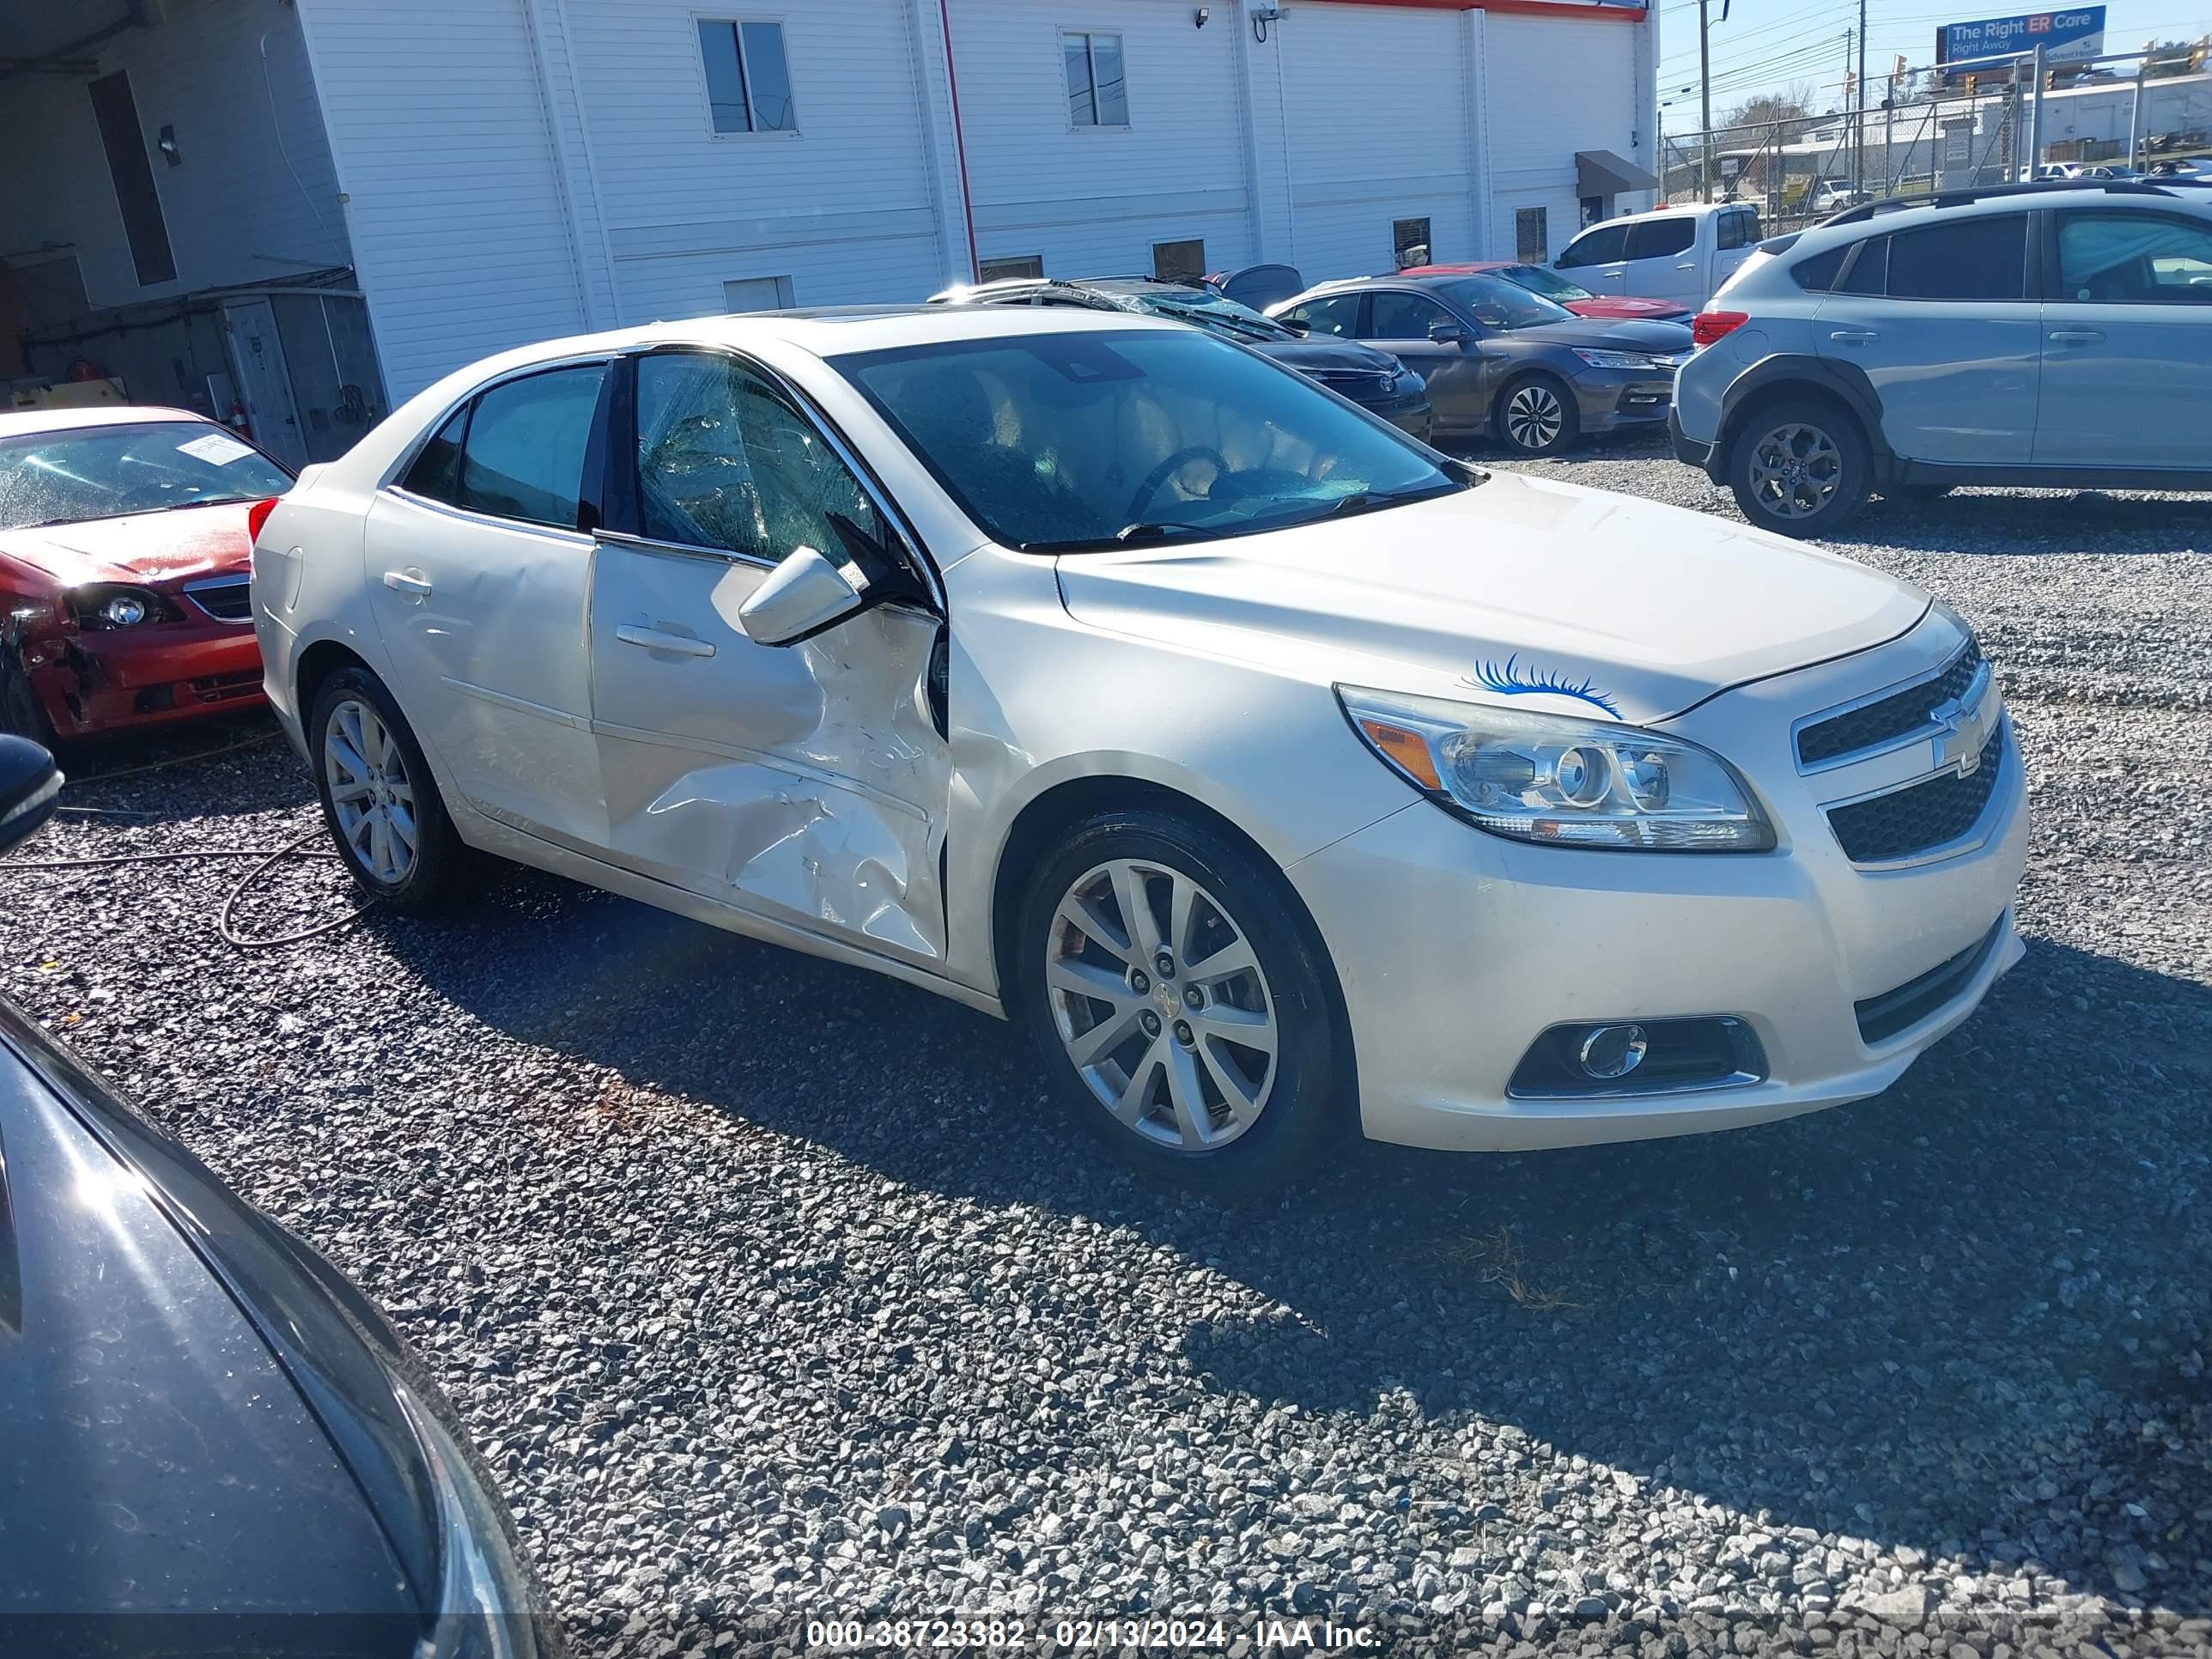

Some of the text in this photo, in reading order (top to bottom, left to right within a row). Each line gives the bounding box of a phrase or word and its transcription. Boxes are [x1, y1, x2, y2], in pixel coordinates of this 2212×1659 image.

[1954, 14, 2091, 40] The Right ER Care
[1953, 40, 2012, 55] Right Away
